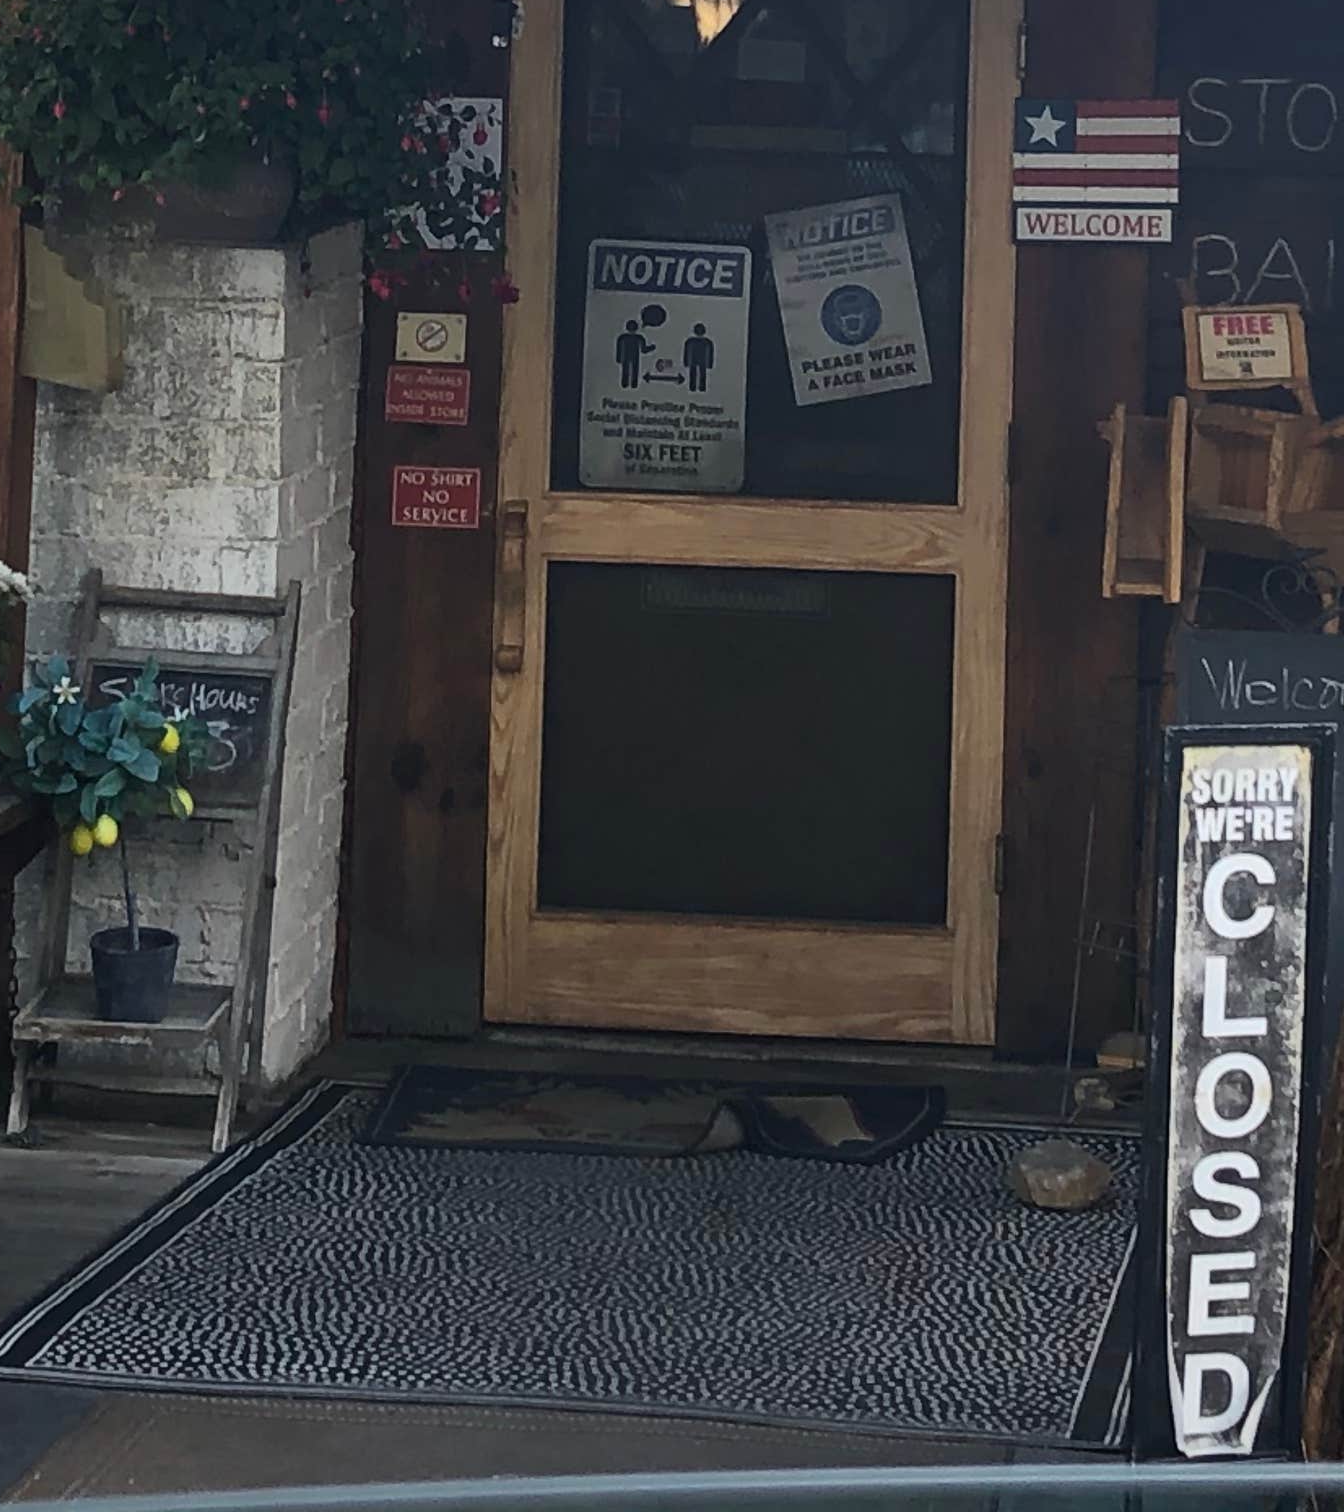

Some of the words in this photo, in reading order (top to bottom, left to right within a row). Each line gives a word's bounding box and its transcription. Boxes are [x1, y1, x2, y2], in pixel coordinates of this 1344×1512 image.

[783, 209, 888, 248] NOTICE
[1024, 212, 1164, 238] WELCOME
[601, 253, 738, 290] NOTICE
[1212, 315, 1275, 336] FREE
[801, 351, 865, 374] PLEASE
[868, 343, 917, 363] WEAR
[807, 378, 820, 391] A
[823, 371, 866, 389] FACE
[869, 361, 918, 380] MASK
[623, 442, 653, 462] SIX
[659, 444, 703, 463] FEET
[400, 472, 426, 486] NO
[430, 472, 474, 488] SHIRT
[422, 489, 450, 505] NO
[402, 506, 469, 523] SERVICE
[1190, 766, 1299, 805] SORRY
[1194, 805, 1295, 843] WE'RE
[1181, 851, 1278, 1436] CLOSED
